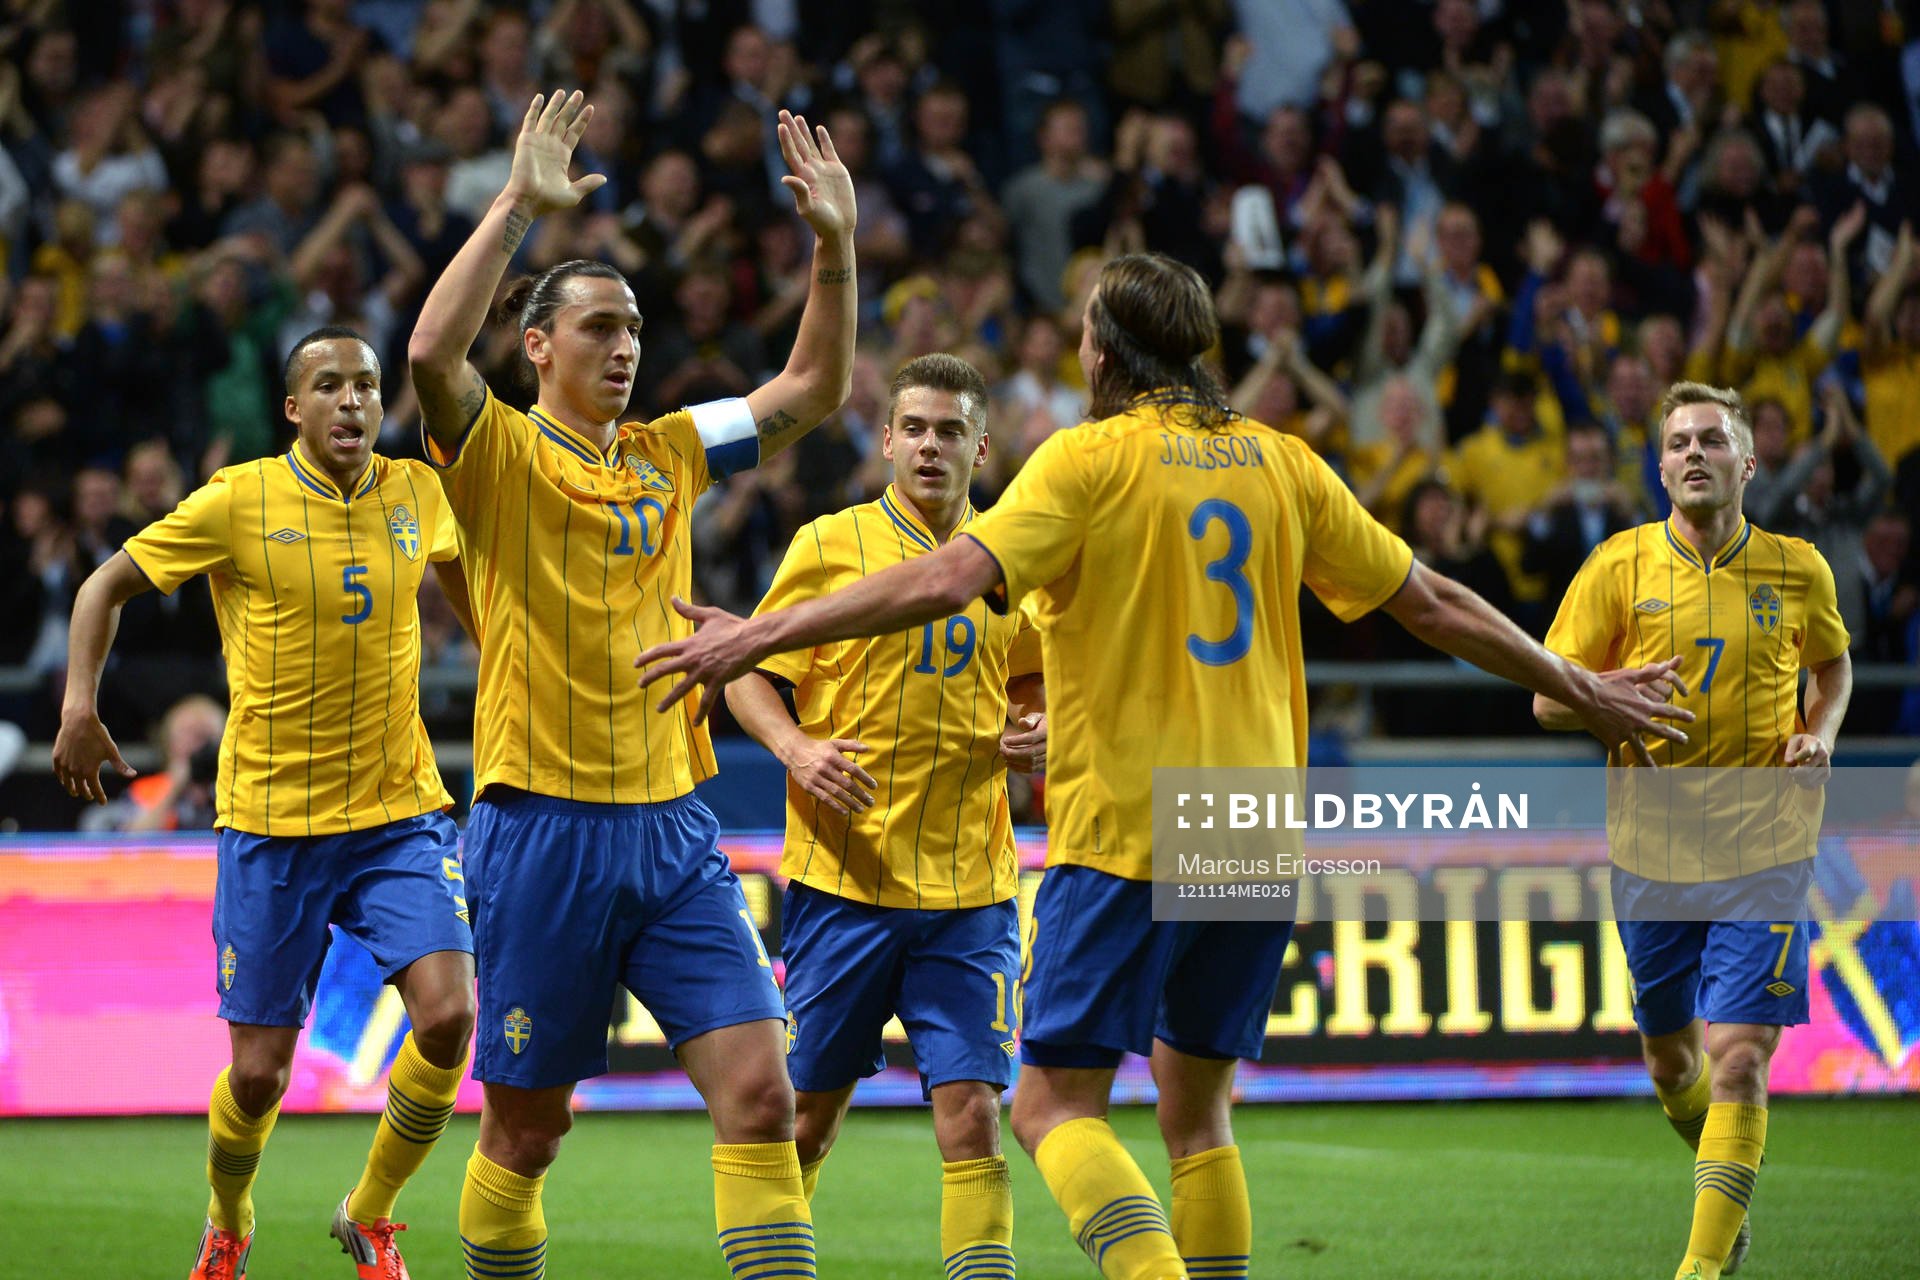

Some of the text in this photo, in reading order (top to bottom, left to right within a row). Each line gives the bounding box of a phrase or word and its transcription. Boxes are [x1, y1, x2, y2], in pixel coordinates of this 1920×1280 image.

[1160, 434, 1264, 470] J.OLSSON
[606, 497, 665, 556] 10
[341, 566, 373, 624] 5
[1186, 498, 1255, 667] 3
[914, 614, 977, 678] 19
[1695, 638, 1725, 693] 7
[1769, 924, 1794, 978] 7
